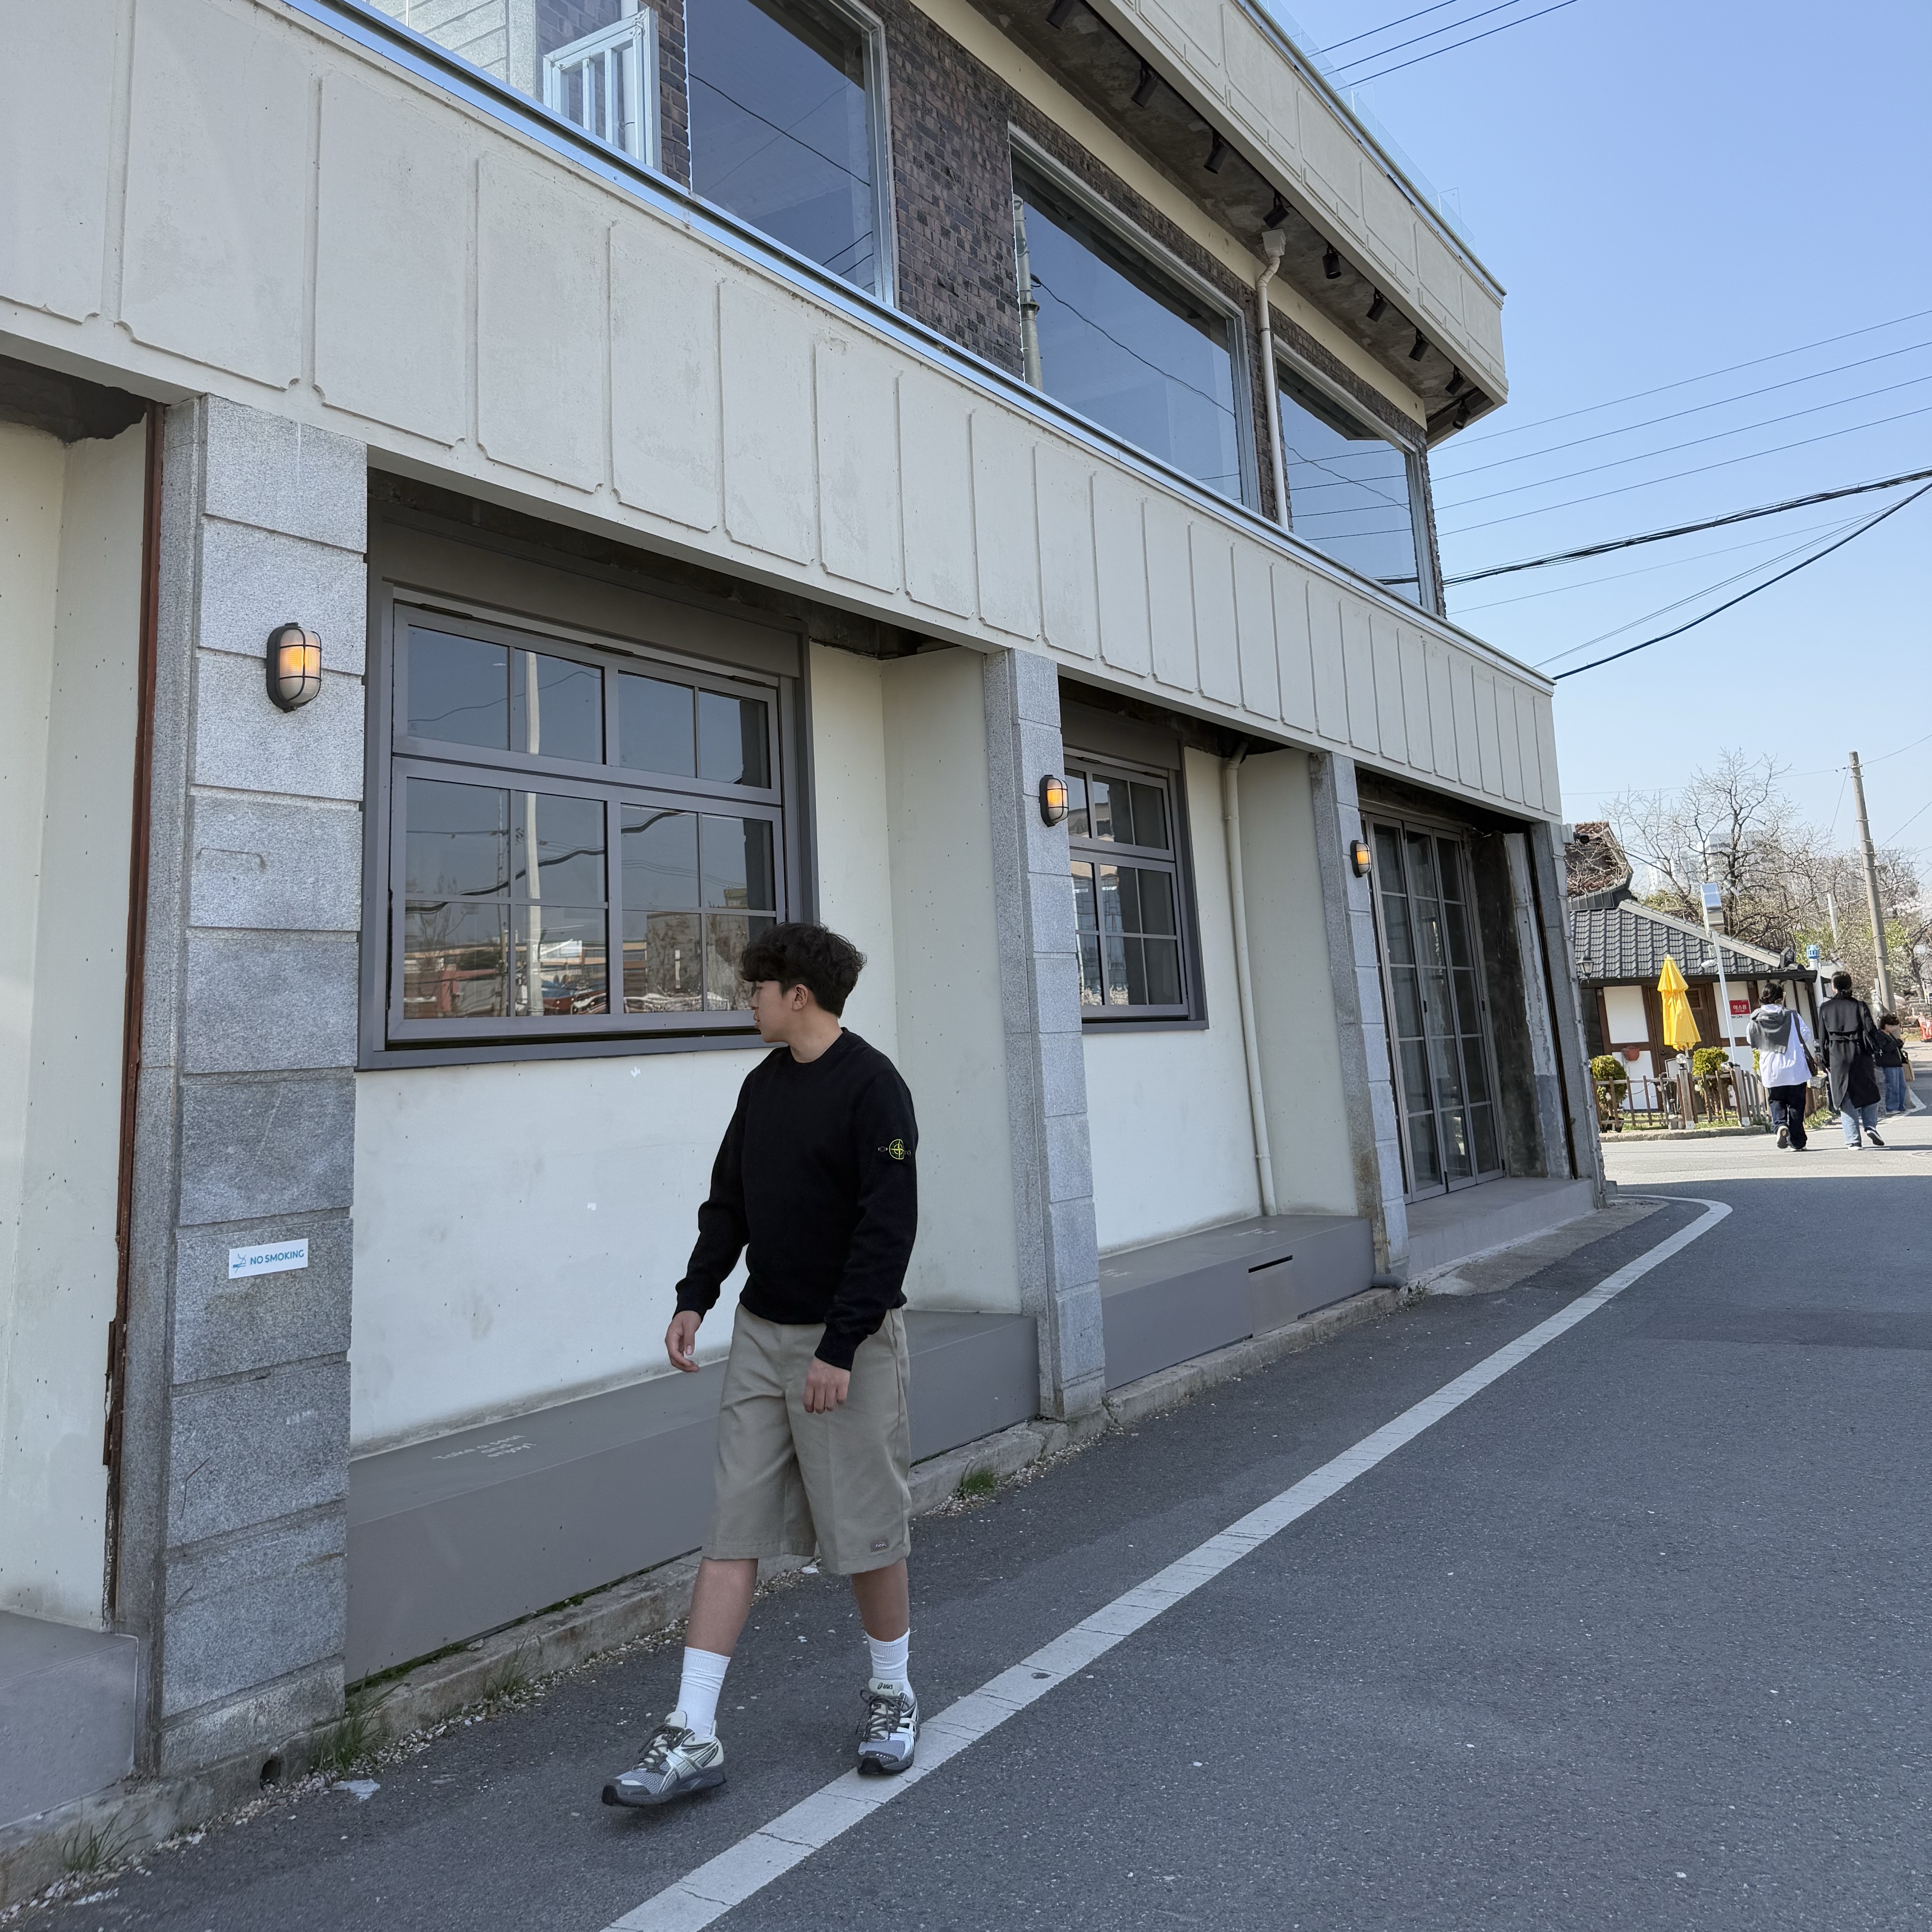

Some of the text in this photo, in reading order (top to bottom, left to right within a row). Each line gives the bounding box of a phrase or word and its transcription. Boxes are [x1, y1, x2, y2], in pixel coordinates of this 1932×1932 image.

[250, 1250, 304, 1265] NO SMOKING
[481, 1444, 514, 1453] and
